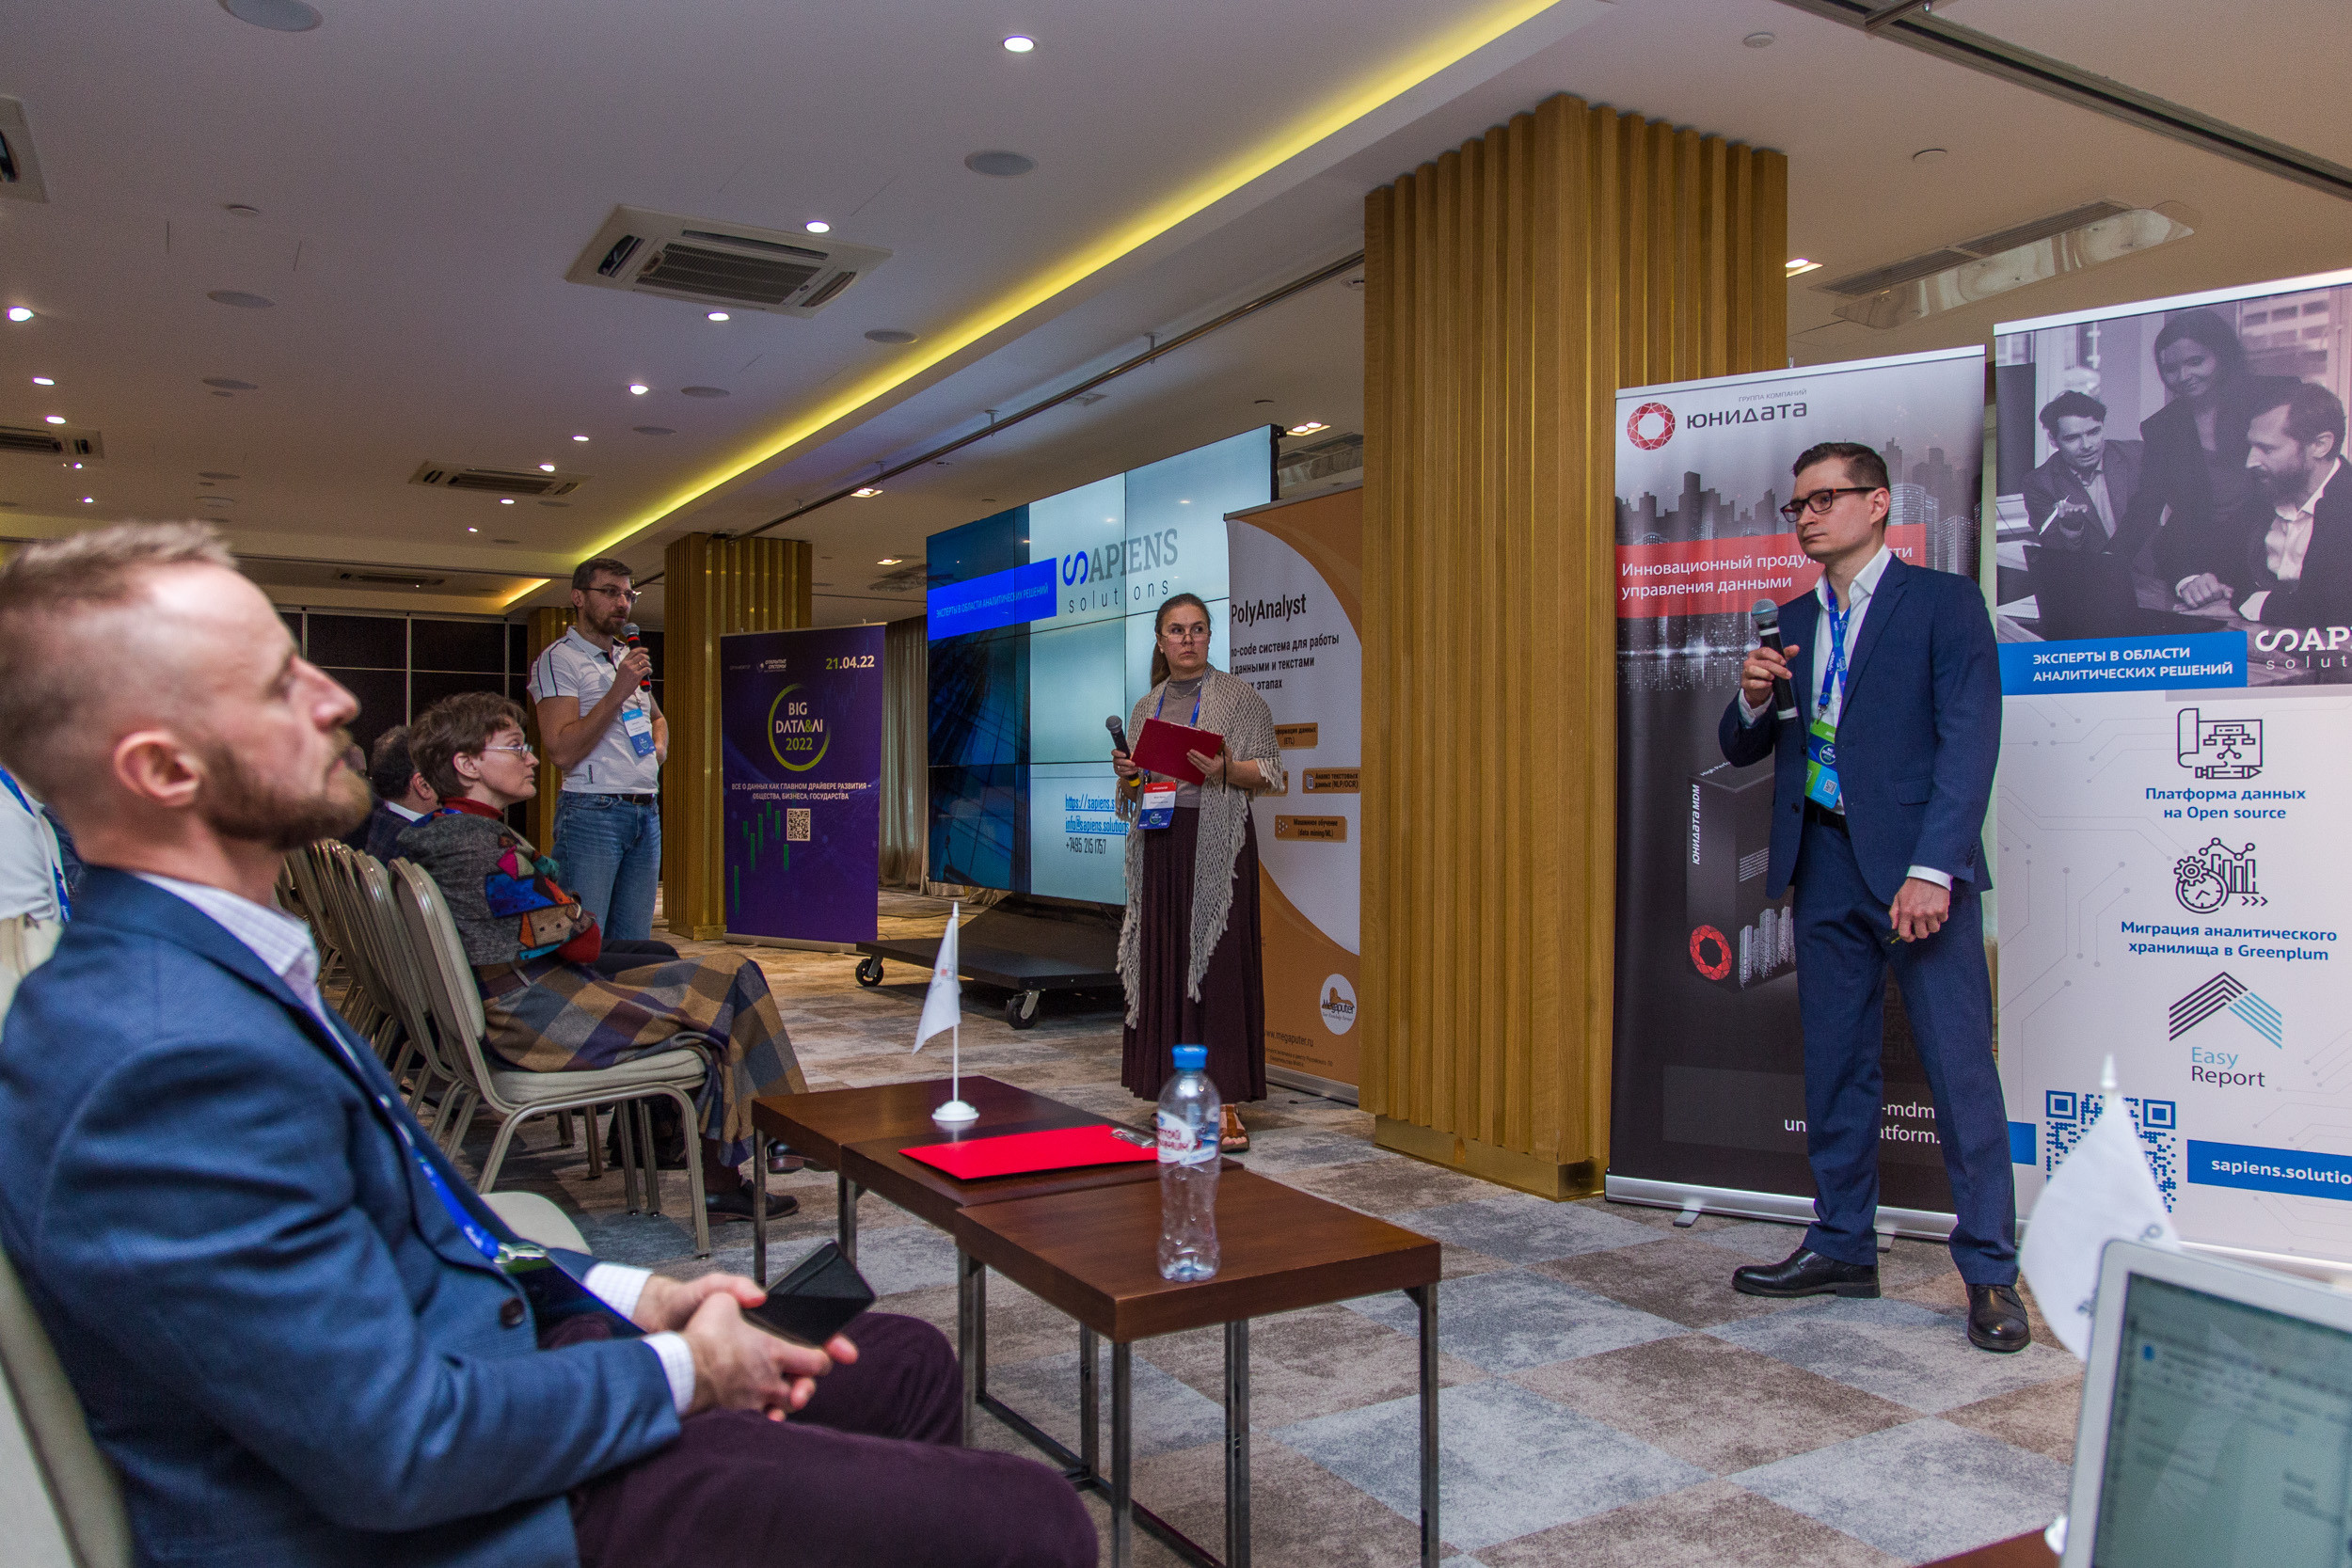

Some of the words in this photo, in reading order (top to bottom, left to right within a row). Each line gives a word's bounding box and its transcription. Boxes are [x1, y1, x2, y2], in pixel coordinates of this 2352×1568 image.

[1739, 394, 1765, 403] ГРУППА
[1766, 388, 1807, 400] КОМПАНИЙ
[1622, 554, 1753, 577] Инновационный
[1756, 553, 1817, 571] продук
[1621, 581, 1716, 600] управления
[1717, 577, 1792, 593] данными
[1231, 594, 1307, 627] PolyAnalyst
[1259, 640, 1291, 654] система
[1292, 638, 1308, 652] для
[1310, 633, 1340, 651] работы
[2255, 626, 2352, 652] SAP
[825, 655, 875, 670] 21.04.22
[2032, 652, 2106, 666] ЭКСПЕРТЫ
[2110, 651, 2120, 661] В
[2122, 647, 2190, 660] ОБЛАСТИ
[1234, 661, 1270, 676] данными
[1271, 661, 1277, 671] и
[1279, 657, 1315, 670] текстами
[2032, 667, 2156, 682] АНАЛИТИЧЕСКИХ
[2159, 661, 2233, 677] РЕШЕНИЙ
[1257, 678, 1283, 690] этапах
[788, 702, 808, 716] BIG
[775, 719, 823, 733] DATA&AI
[786, 736, 813, 751] 2022
[807, 782, 836, 790] ДРАЙВЕРЕ
[2145, 787, 2237, 802] Платформа
[2241, 789, 2306, 801] данных
[809, 792, 849, 800] ГОСУДАРСТВА
[2164, 809, 2182, 818] на
[2186, 806, 2229, 821] Open
[2233, 809, 2287, 819] source
[2121, 921, 2200, 937] Миграция
[2204, 927, 2337, 942] аналитического
[2128, 942, 2218, 957] хранилища
[2224, 946, 2233, 956] в
[2238, 944, 2329, 961] Greenplum
[1323, 999, 1354, 1014] Megaputer
[2191, 1046, 2239, 1069] Easy
[2191, 1065, 2265, 1087] Report
